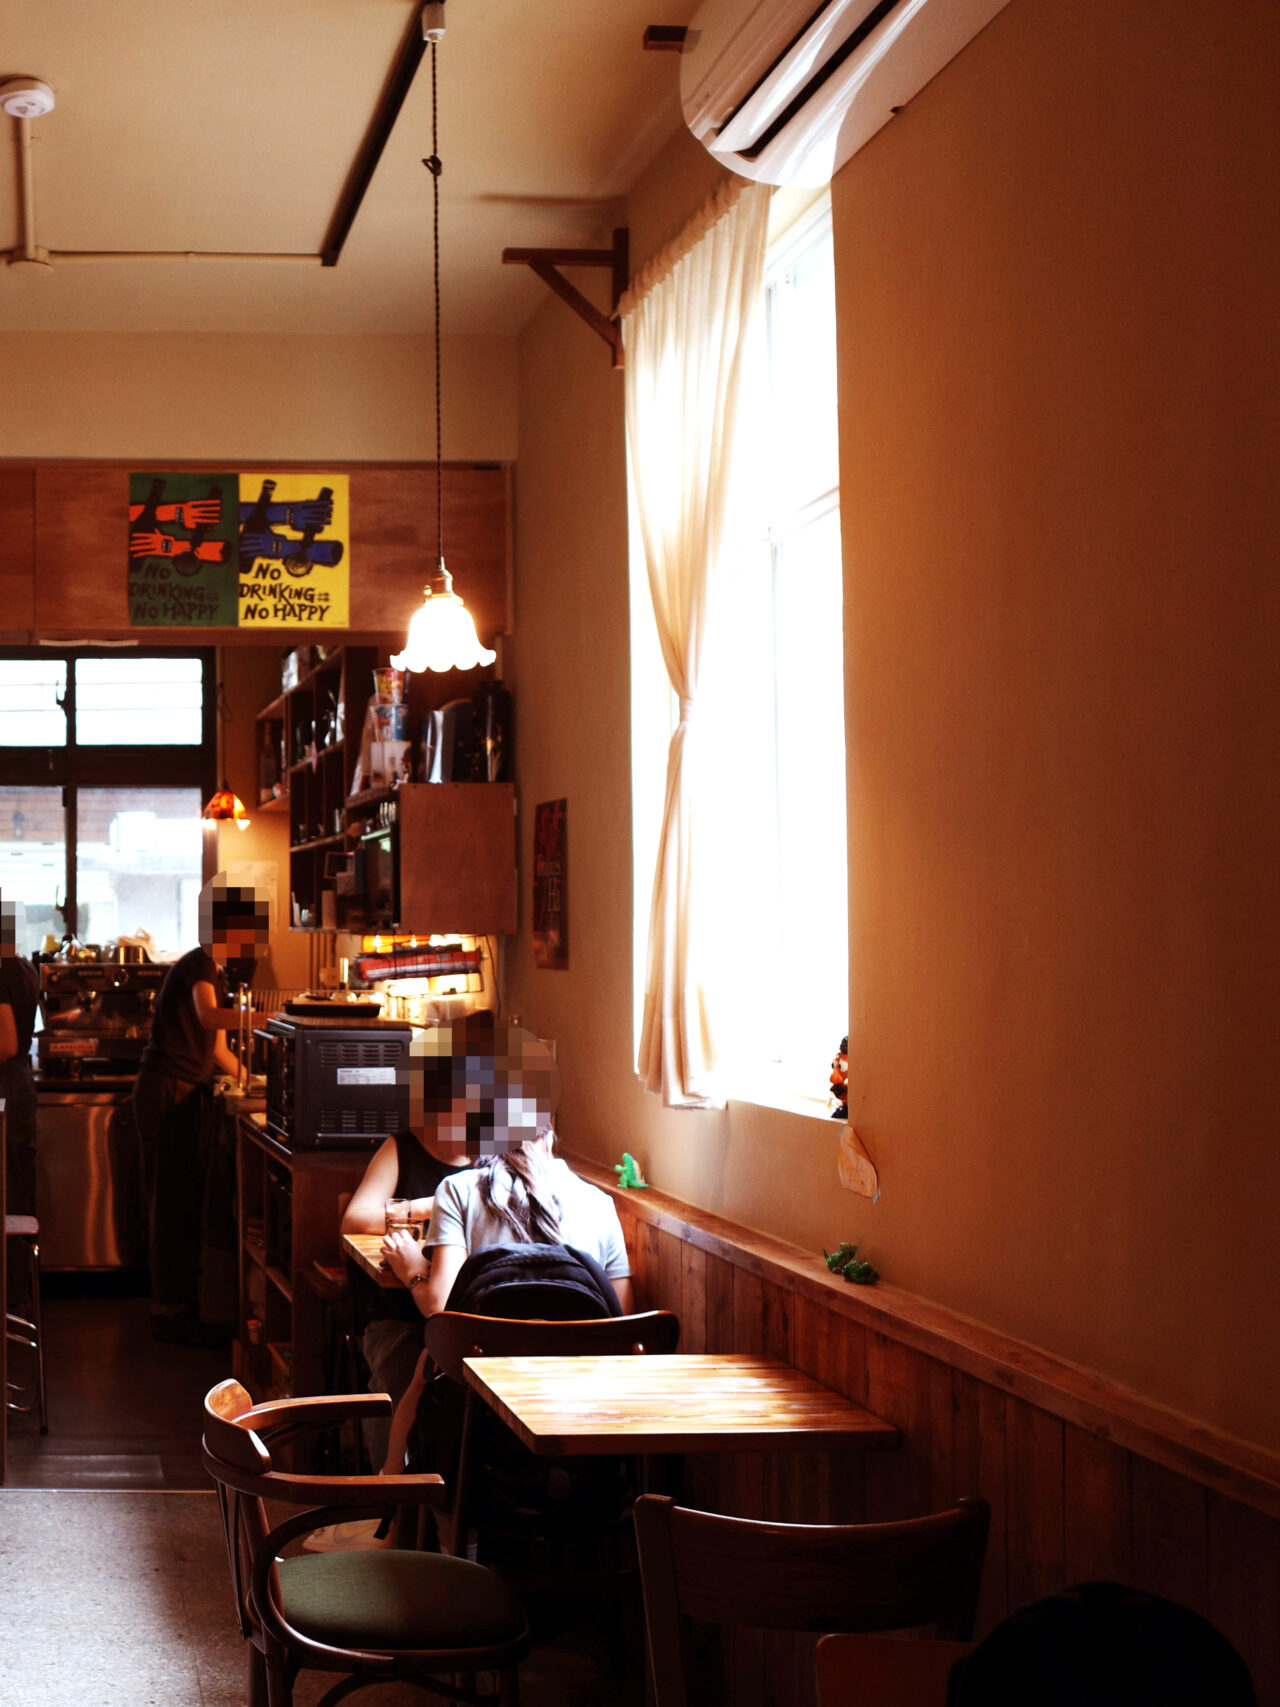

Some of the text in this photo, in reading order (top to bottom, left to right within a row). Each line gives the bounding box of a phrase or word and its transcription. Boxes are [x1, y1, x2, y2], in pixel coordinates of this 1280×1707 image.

[130, 583, 205, 606] DRINKING
[239, 583, 315, 606] DRINKING
[163, 602, 220, 620] HAPPY
[273, 603, 330, 621] HAPPY
